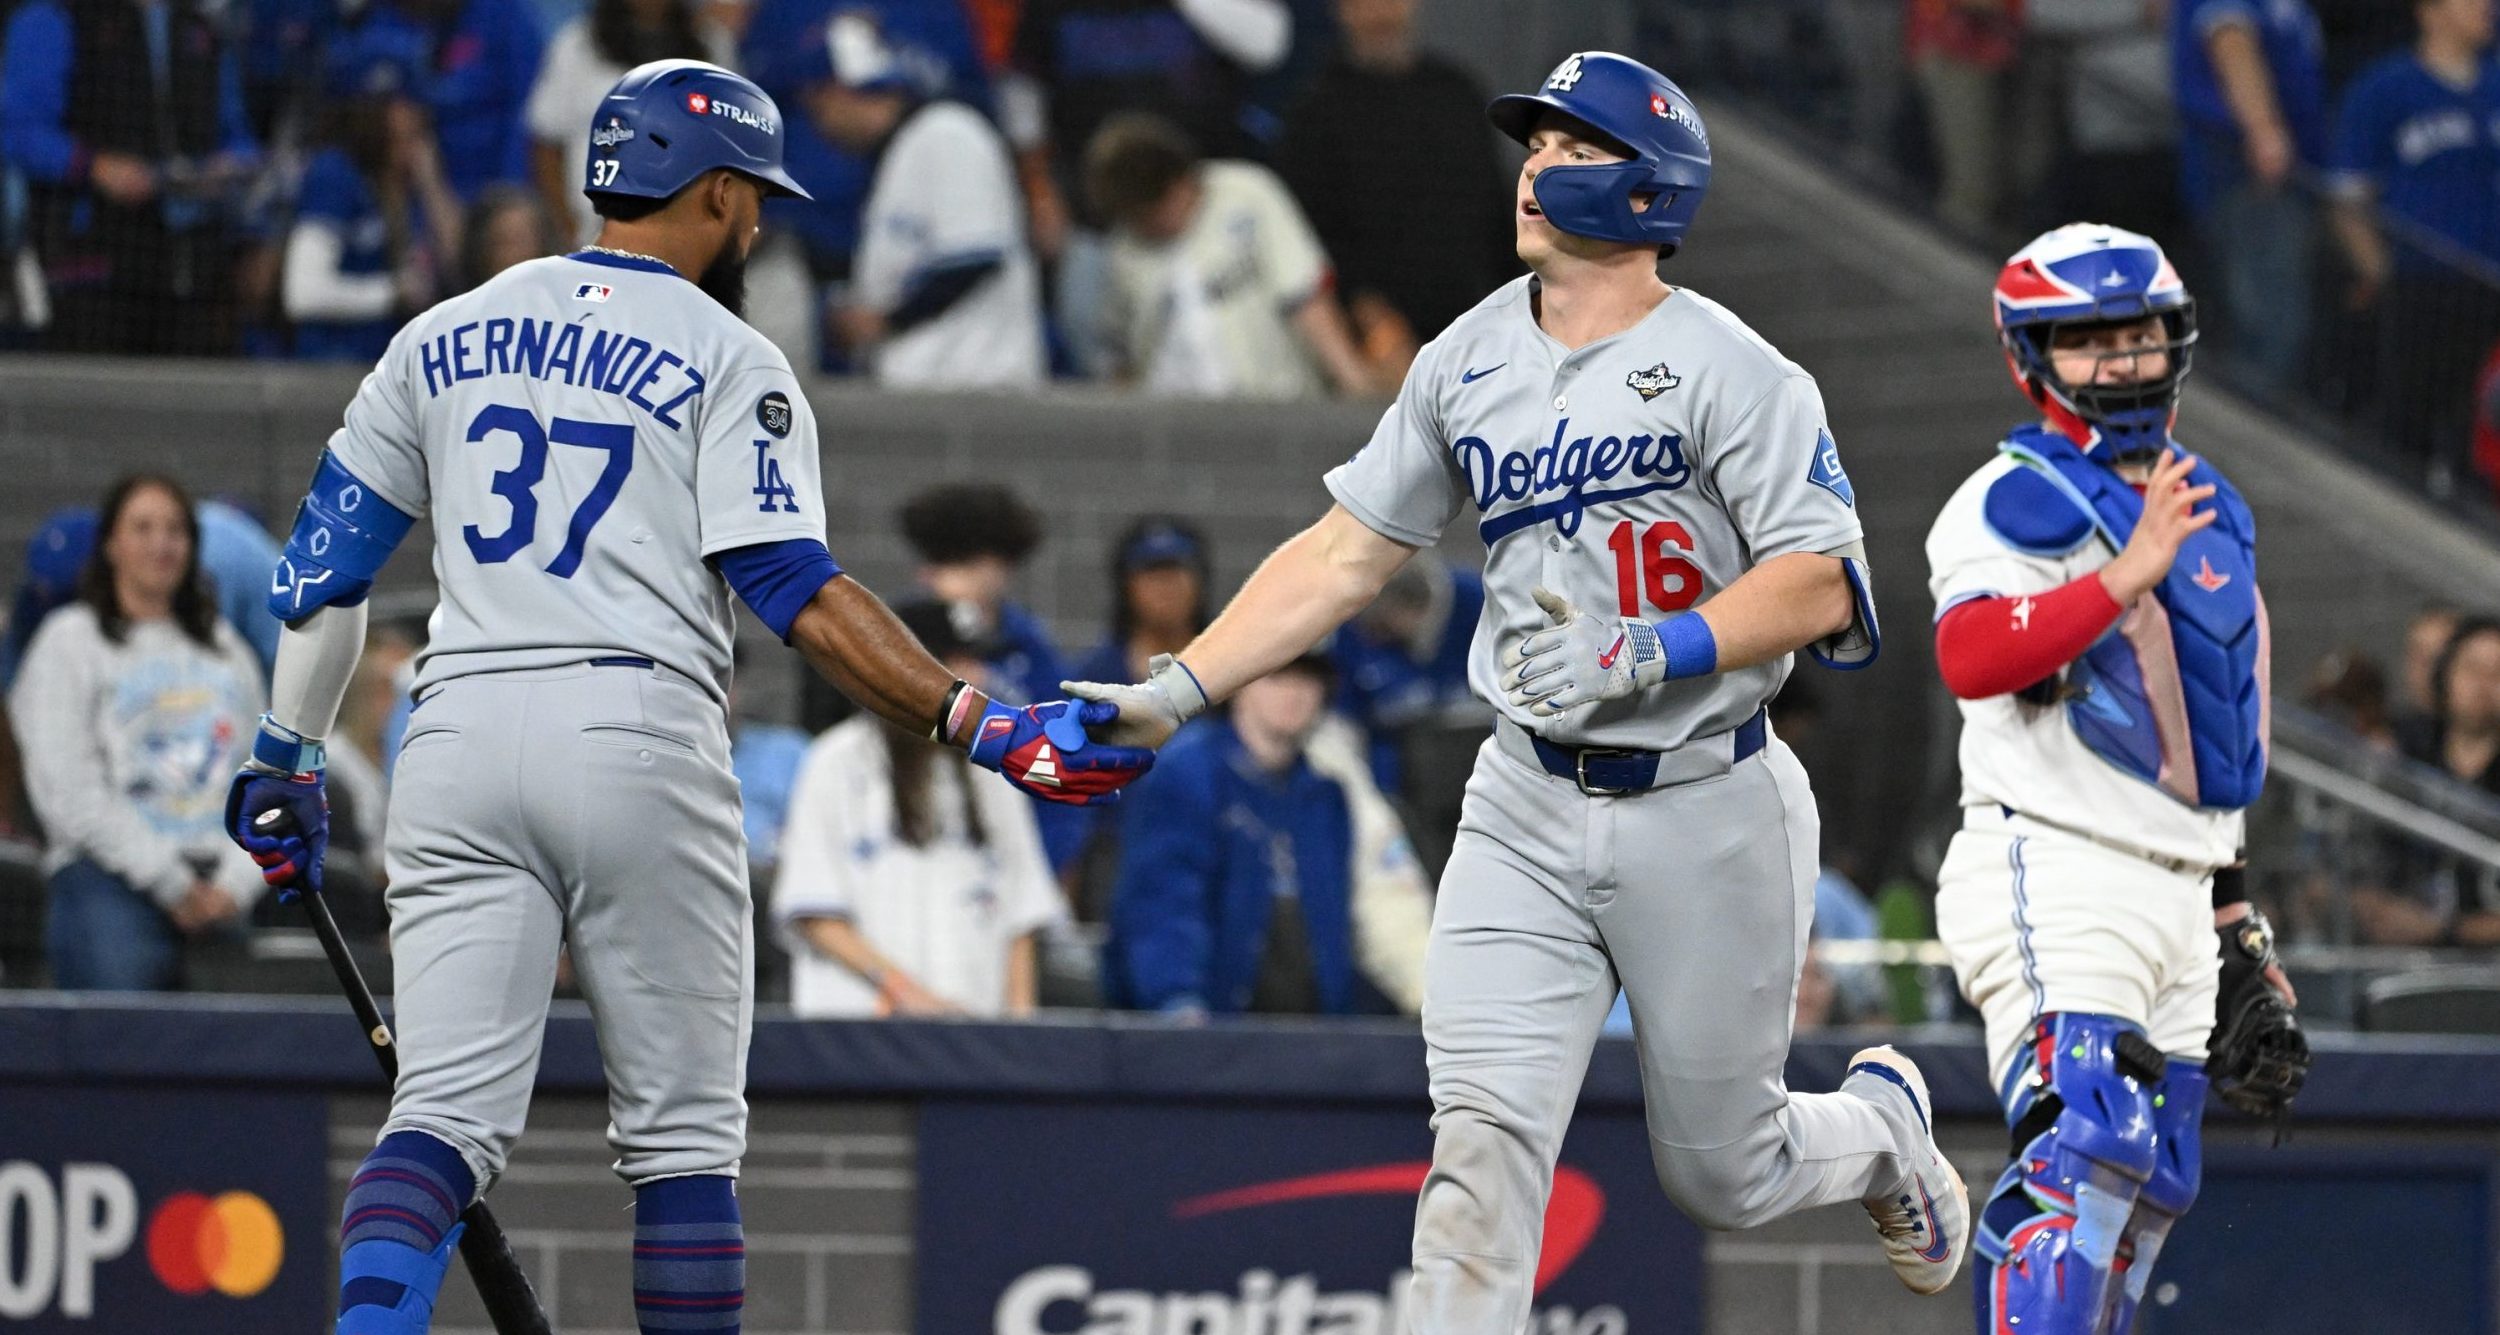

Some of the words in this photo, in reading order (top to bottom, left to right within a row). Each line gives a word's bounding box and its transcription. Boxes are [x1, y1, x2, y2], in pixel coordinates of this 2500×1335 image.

[711, 99, 775, 136] STRAUSS
[1669, 105, 1710, 151] STRAU
[593, 159, 620, 187] 37
[420, 312, 707, 433] HERNÁNDEZ
[766, 407, 788, 433] 34
[463, 403, 635, 580] 37
[753, 440, 800, 513] LA
[1453, 417, 1691, 539] Dodgers
[1608, 520, 1704, 617] 16
